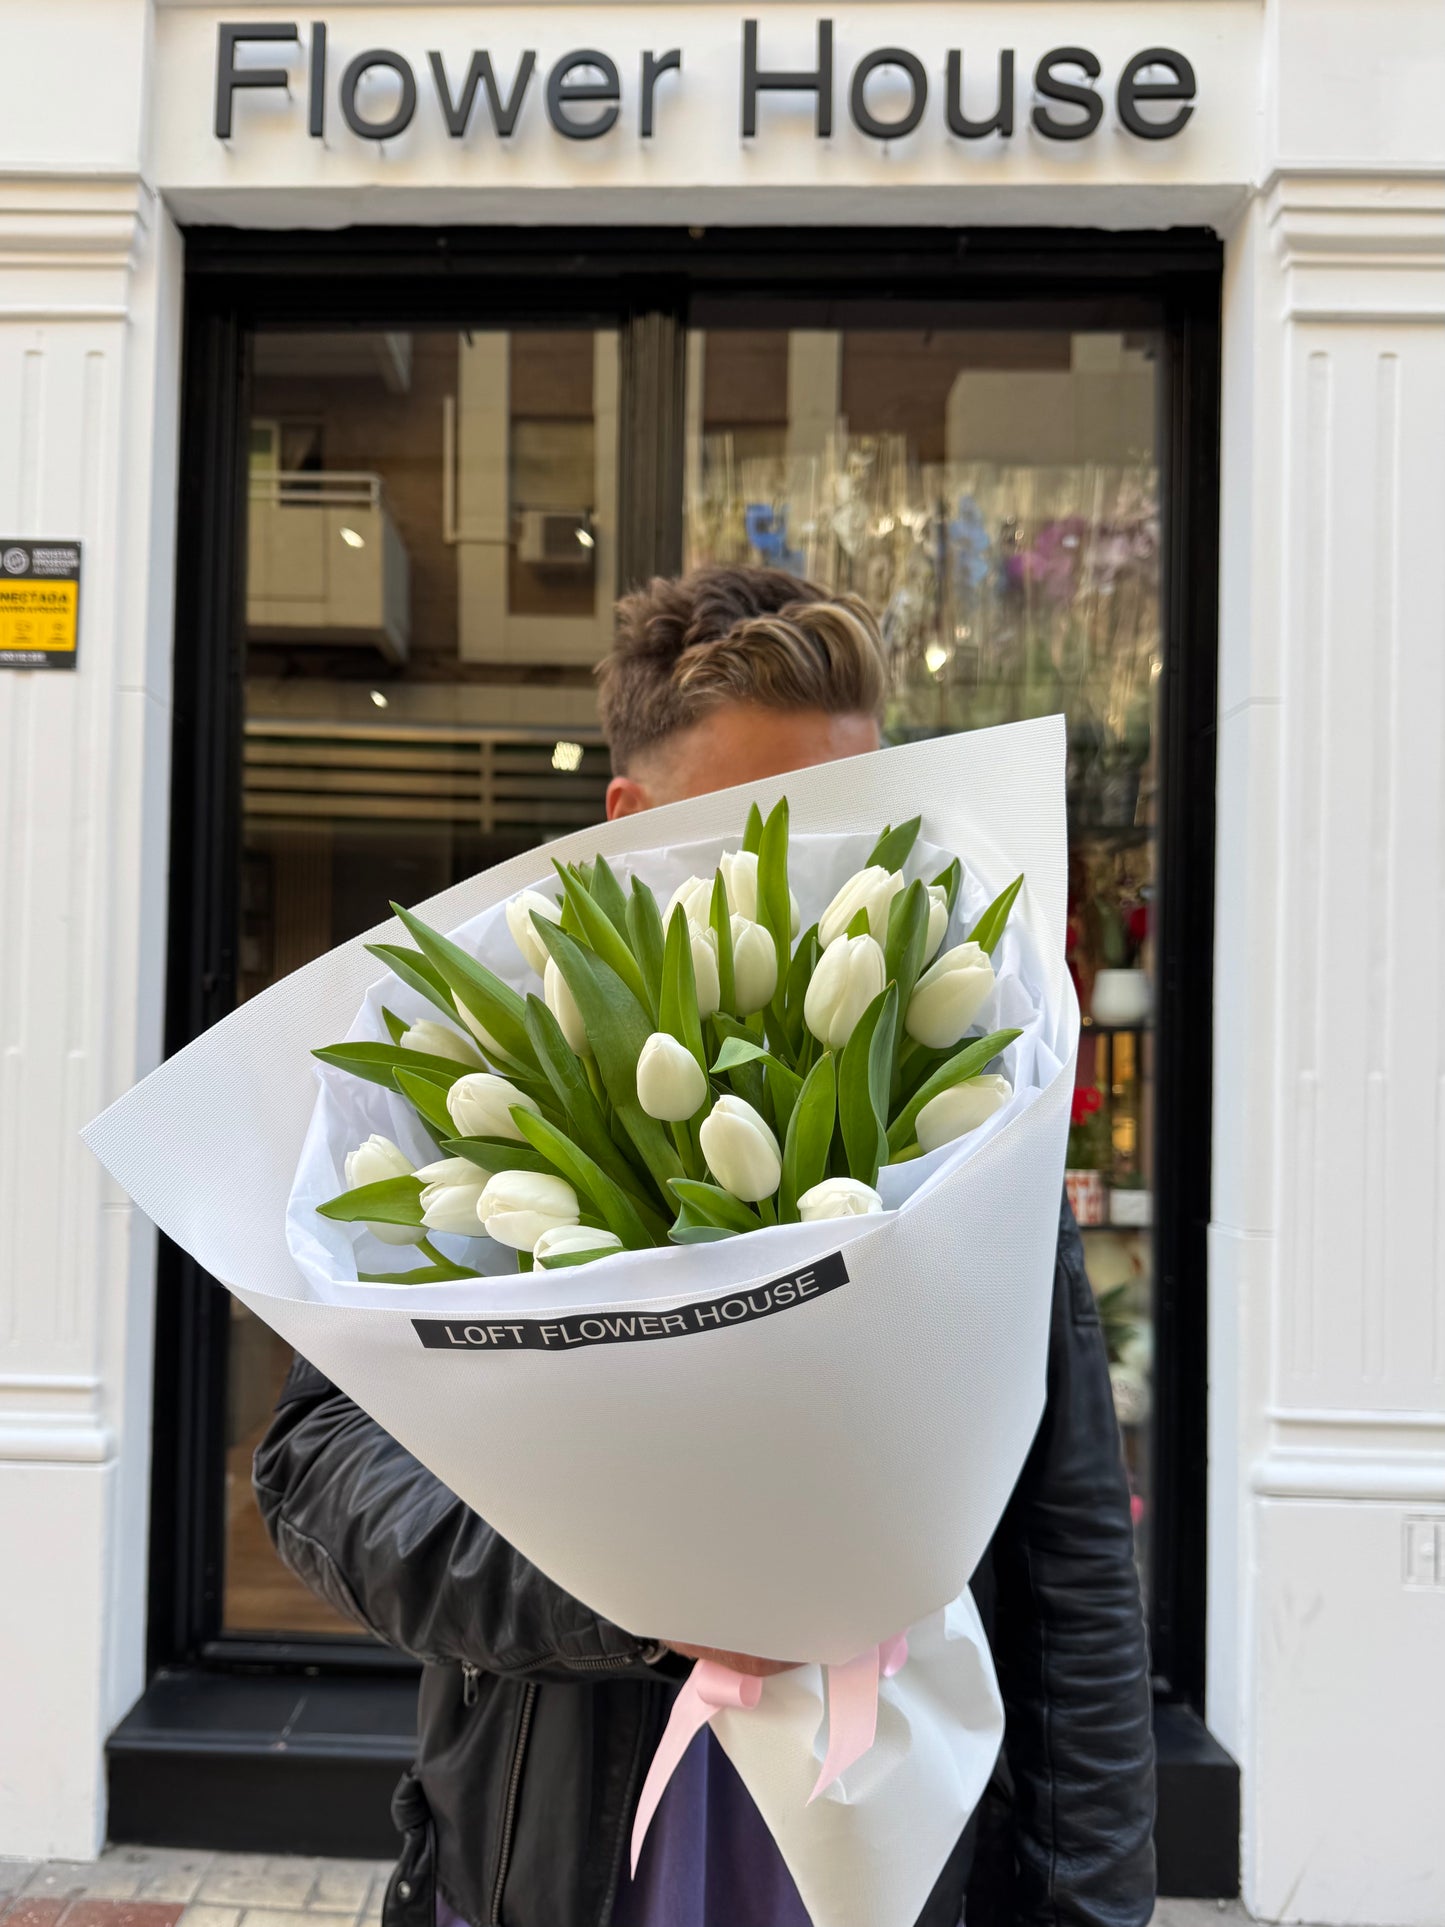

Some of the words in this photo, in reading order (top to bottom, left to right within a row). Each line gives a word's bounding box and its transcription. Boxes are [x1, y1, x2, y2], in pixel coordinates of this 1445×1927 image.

[214, 22, 681, 141] Flower
[741, 19, 1197, 142] House
[444, 1324, 525, 1346] LOFT
[539, 1313, 688, 1346] FLOWER
[694, 1270, 820, 1327] HOUSE
